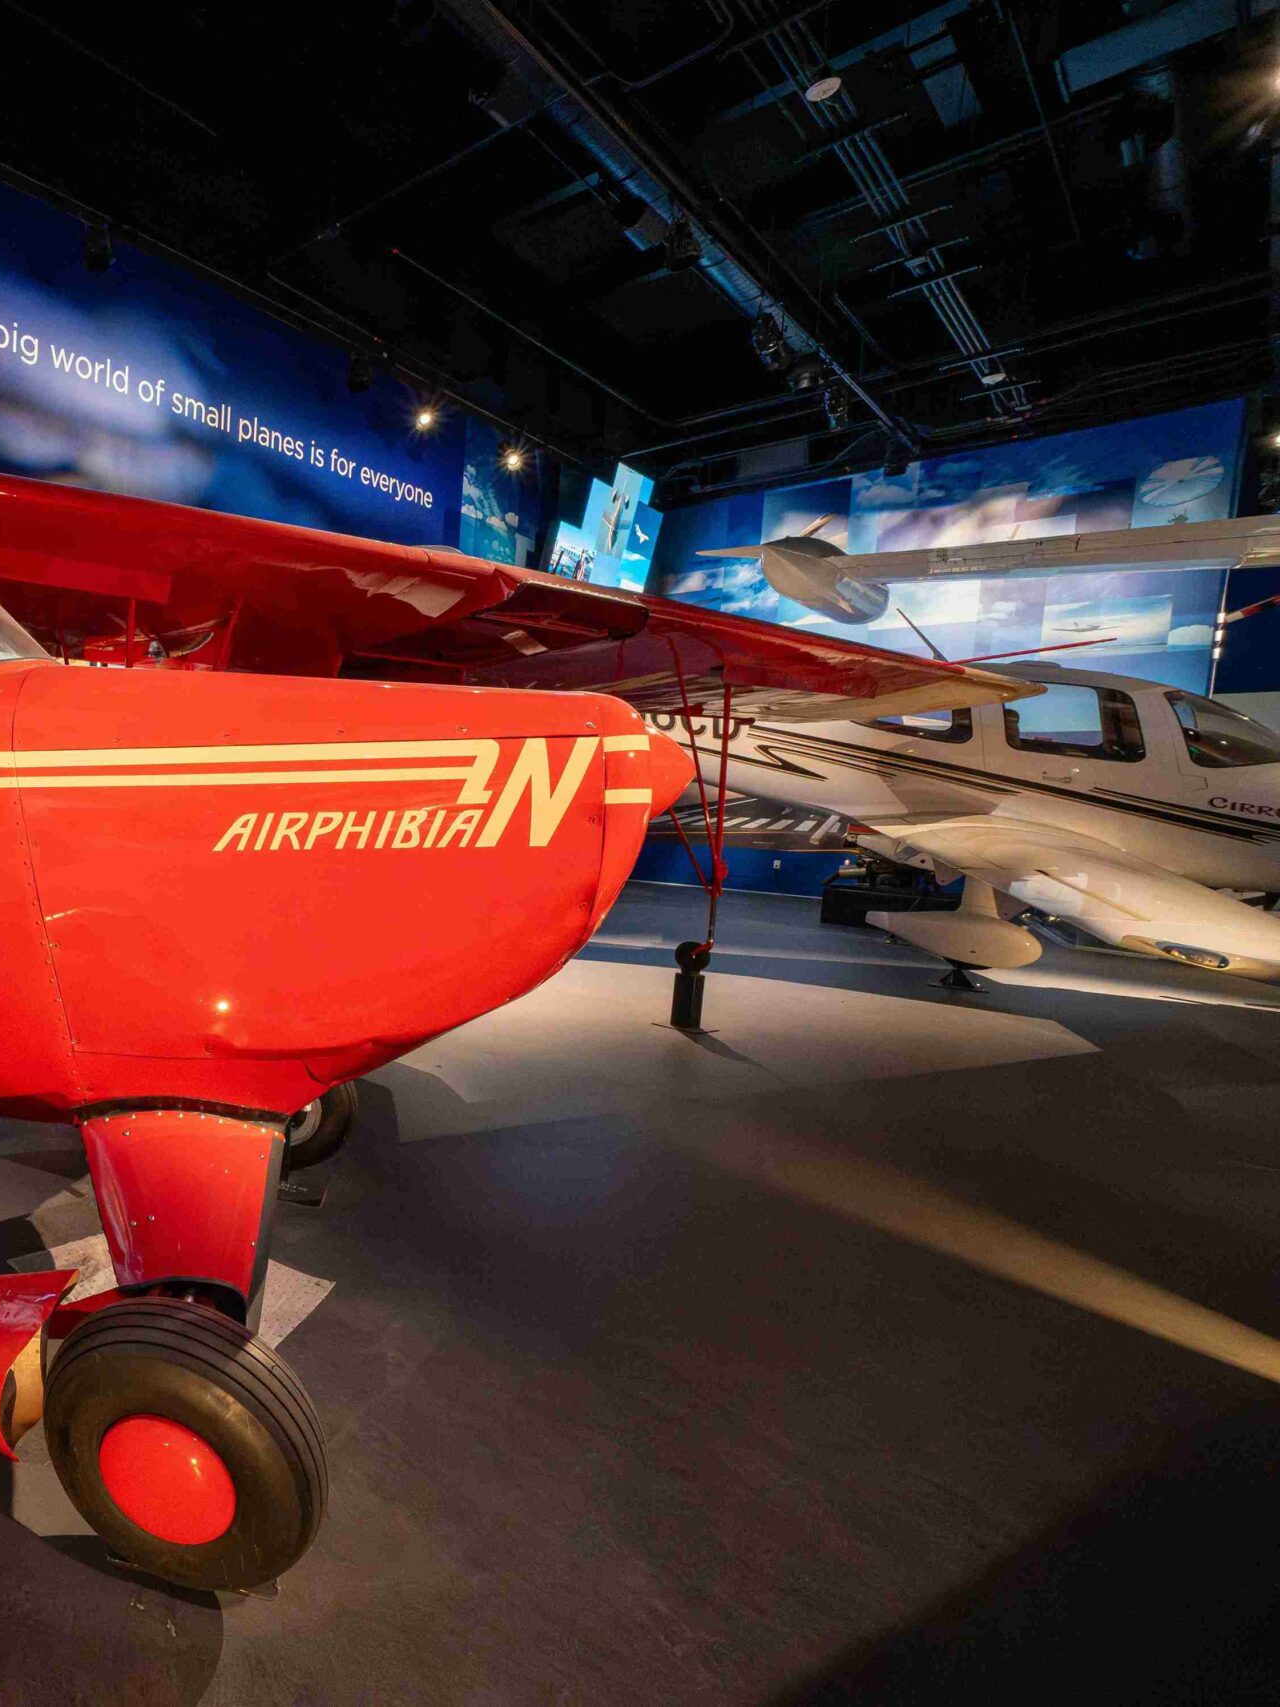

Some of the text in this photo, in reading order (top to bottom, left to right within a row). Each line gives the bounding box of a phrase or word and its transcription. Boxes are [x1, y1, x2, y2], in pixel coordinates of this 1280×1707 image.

[50, 344, 129, 394] world
[138, 379, 165, 406] of
[171, 392, 231, 432] small
[238, 417, 304, 460] planes
[310, 440, 325, 467] is
[330, 448, 356, 479] for
[360, 466, 433, 508] everyone
